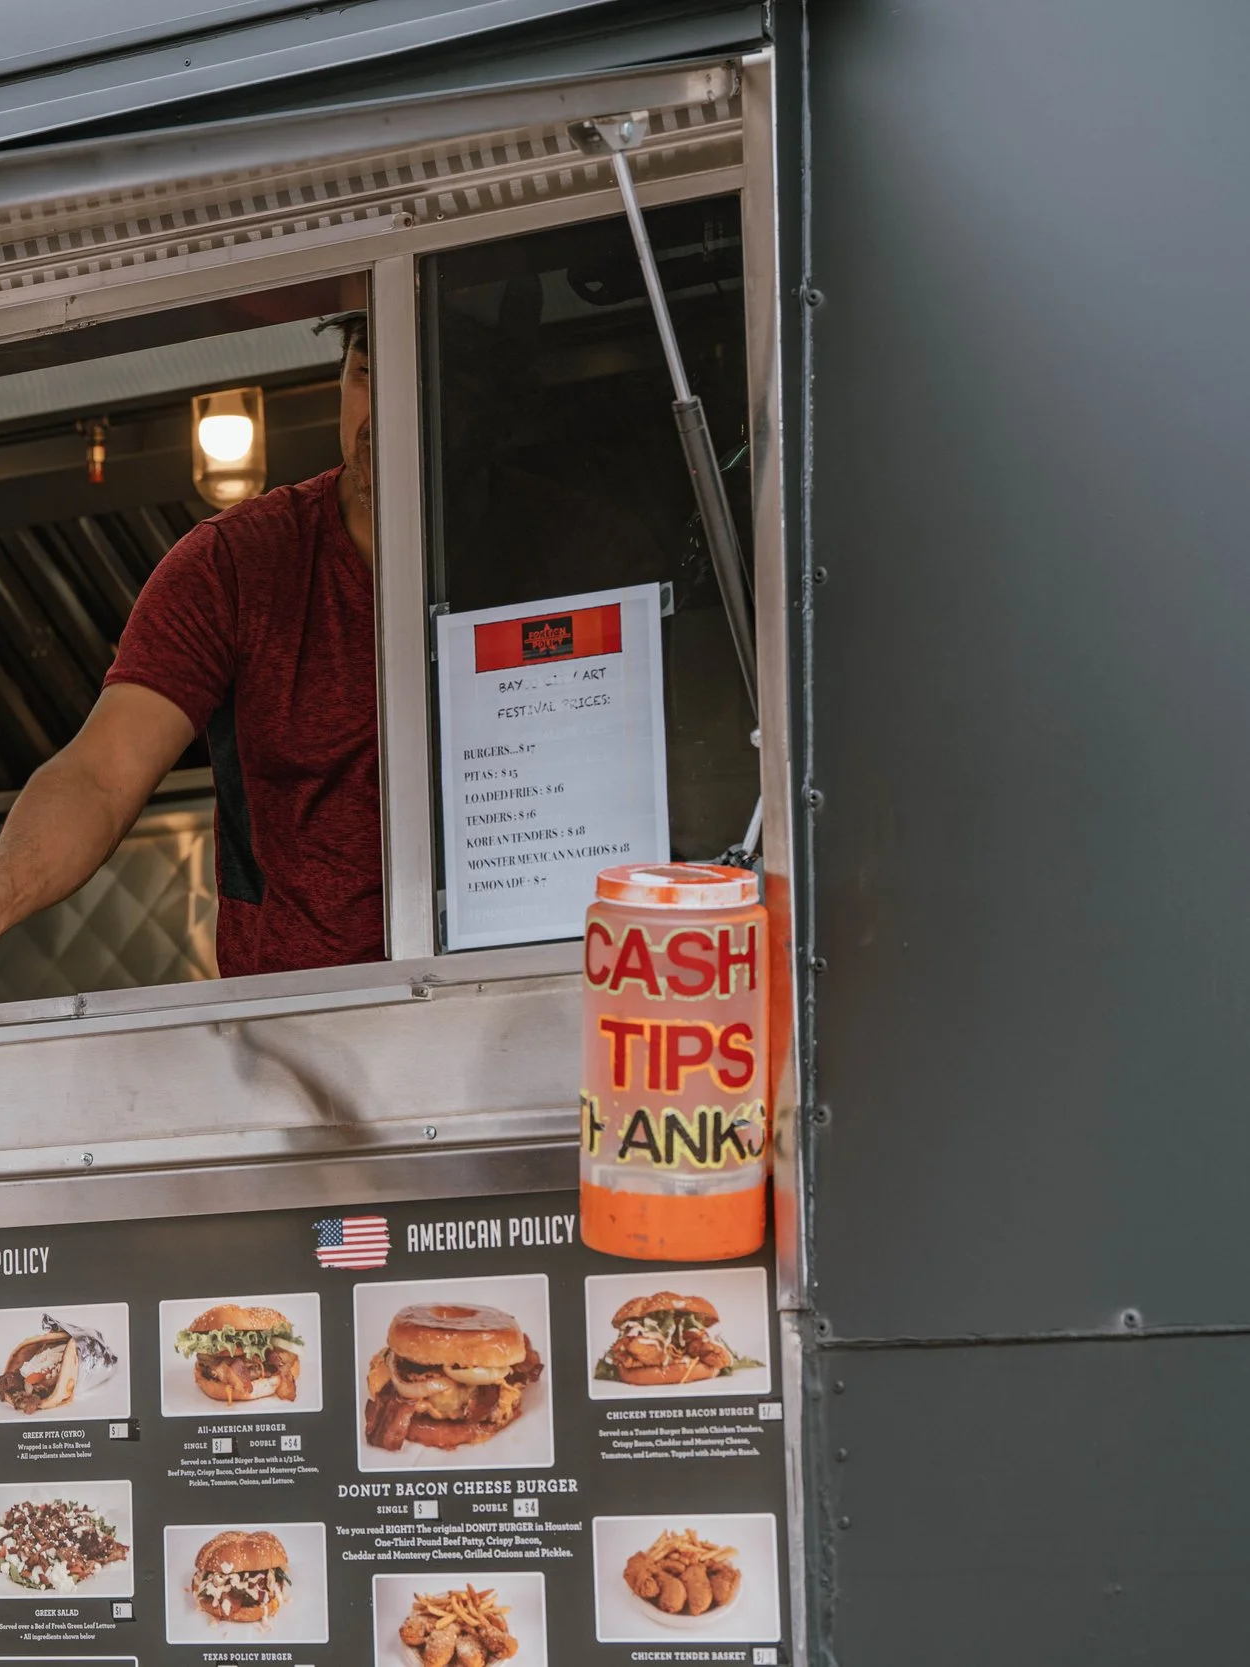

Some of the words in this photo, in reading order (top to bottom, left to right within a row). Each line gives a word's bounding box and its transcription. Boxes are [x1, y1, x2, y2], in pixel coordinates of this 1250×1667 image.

[583, 668, 606, 680] ART
[498, 701, 556, 719] FESTIVAL
[465, 790, 508, 805] LOADED
[467, 834, 509, 849] KOREAN
[468, 856, 515, 870] MONSTER
[518, 851, 565, 865] MEXICAN
[568, 844, 610, 860] NACHOS
[584, 919, 758, 1002] CASH
[599, 1016, 758, 1095] TIPS
[407, 1219, 502, 1252] AMERICAN
[508, 1214, 575, 1247] POLICY
[606, 1410, 646, 1419] CHICKEN
[648, 1409, 683, 1418] TENDER
[685, 1408, 716, 1417] BACON
[718, 1406, 754, 1416] BURGER
[60, 1429, 85, 1439] (GYRO)
[197, 1424, 253, 1433] All-AMERICAN
[255, 1423, 286, 1431] BURGER
[338, 1483, 390, 1497] DONUT
[395, 1482, 447, 1495] BACON
[453, 1480, 511, 1494] CHEESE
[516, 1478, 577, 1492] BURGER
[377, 1506, 408, 1514] SINGLE
[472, 1504, 508, 1512] DOUBLE
[336, 1526, 349, 1534] Yes
[350, 1528, 365, 1536] you
[366, 1524, 384, 1534] read
[385, 1524, 414, 1533] RIGHT!
[416, 1523, 431, 1533] The
[432, 1522, 464, 1534] original
[465, 1522, 497, 1532] DONUT
[498, 1522, 533, 1531] BURGER
[534, 1522, 543, 1530] in
[544, 1521, 582, 1530] Houston!
[374, 1536, 415, 1546] One-Third
[416, 1536, 441, 1546] Pound
[442, 1536, 460, 1545] Beef
[485, 1535, 513, 1546] Crispy
[342, 1550, 375, 1560] Cheddar
[376, 1550, 391, 1559] and
[392, 1550, 430, 1560] Monterey
[464, 1548, 492, 1558] Grilled
[493, 1548, 523, 1557] Onions
[524, 1547, 540, 1557] and
[631, 1651, 672, 1660] CHICKEN
[674, 1651, 709, 1660] TENDER
[711, 1651, 746, 1660] BASKET
